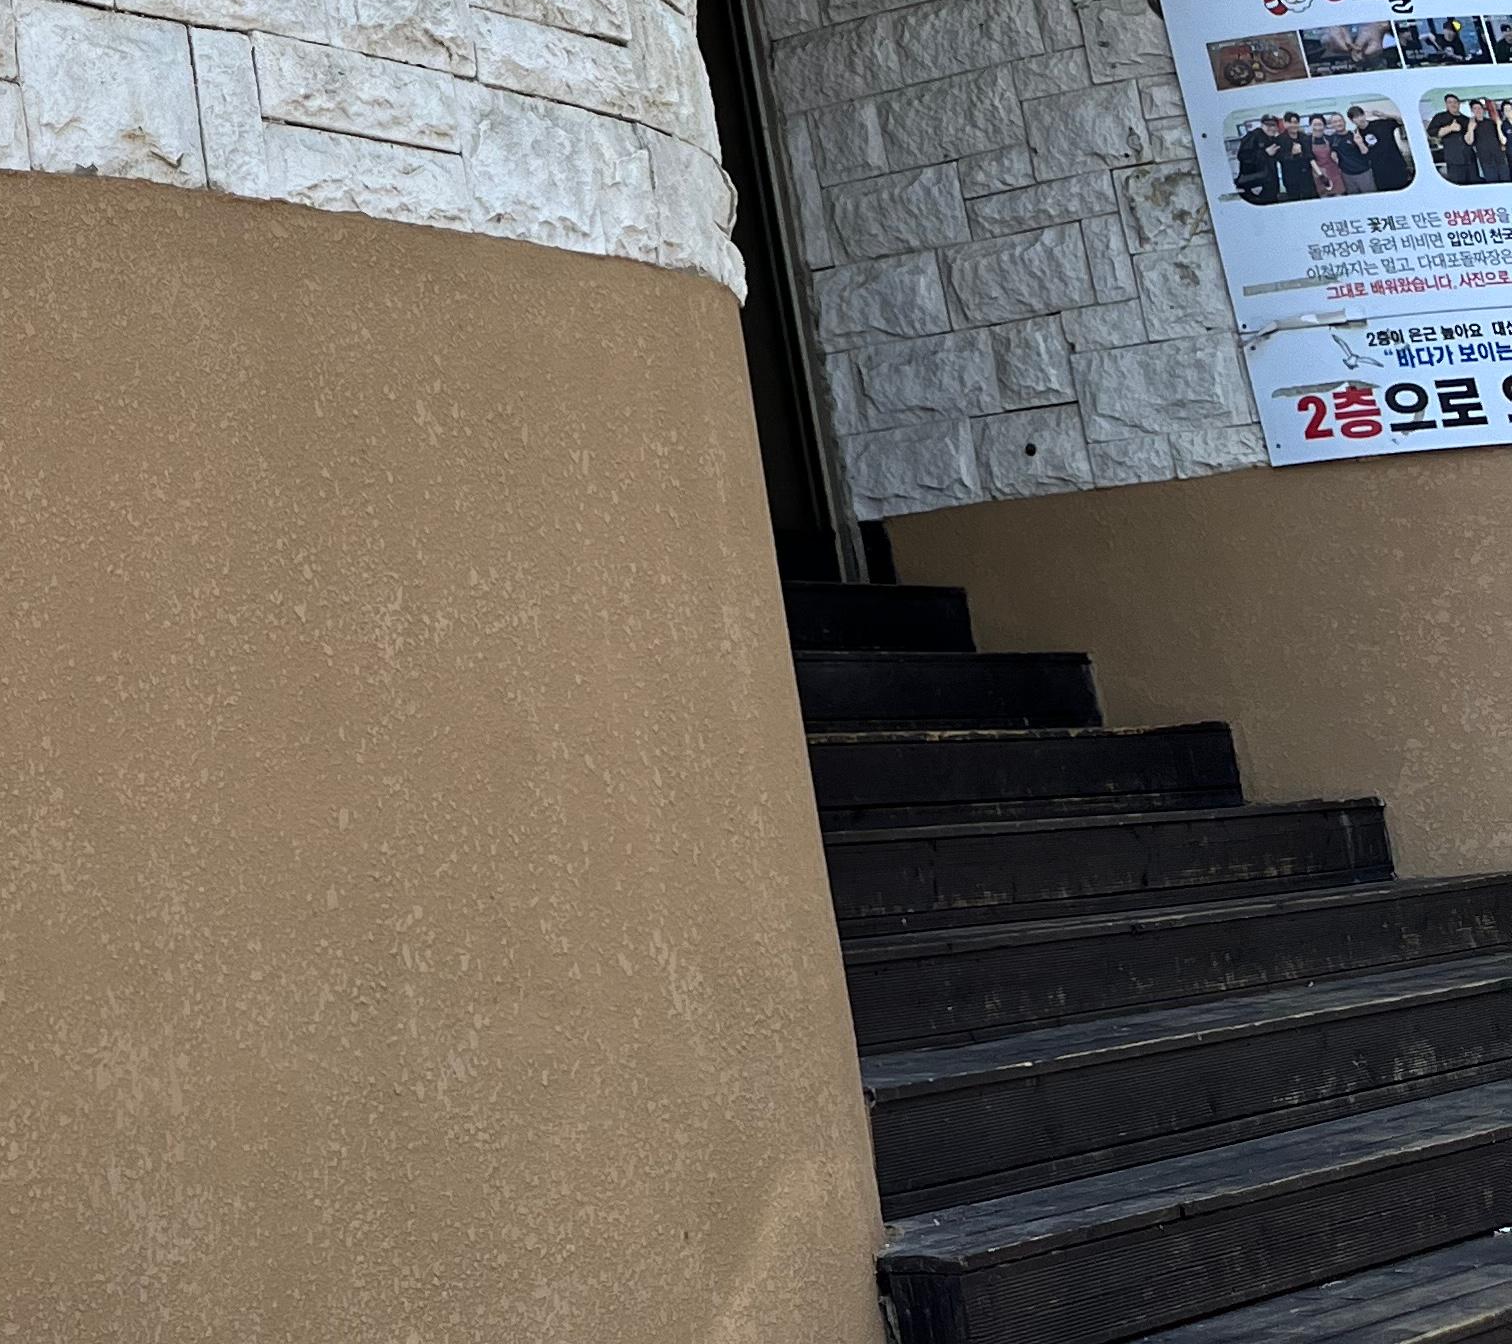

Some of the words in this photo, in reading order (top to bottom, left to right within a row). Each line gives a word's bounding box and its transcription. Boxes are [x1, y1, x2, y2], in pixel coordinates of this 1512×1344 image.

[1320, 219, 1365, 238] 연평도
[1367, 215, 1411, 234] 꽃게로
[1412, 211, 1443, 229] 만든
[1444, 207, 1511, 227] 양념게장을
[1307, 239, 1366, 261] 돌짜장에
[1369, 235, 1399, 255] 올려
[1401, 231, 1445, 250] 비비면
[1447, 229, 1488, 247] 입안이
[1306, 260, 1380, 281] 이천까지는
[1380, 257, 1415, 274] 멀고
[1326, 281, 1368, 300] 그대로
[1459, 269, 1512, 289] 사진으로
[1366, 329, 1405, 347] 2층이
[1408, 326, 1437, 343] 은근
[1440, 322, 1483, 341] 높아요
[1458, 341, 1512, 364] 보이는
[1297, 377, 1488, 439] 2층으로
